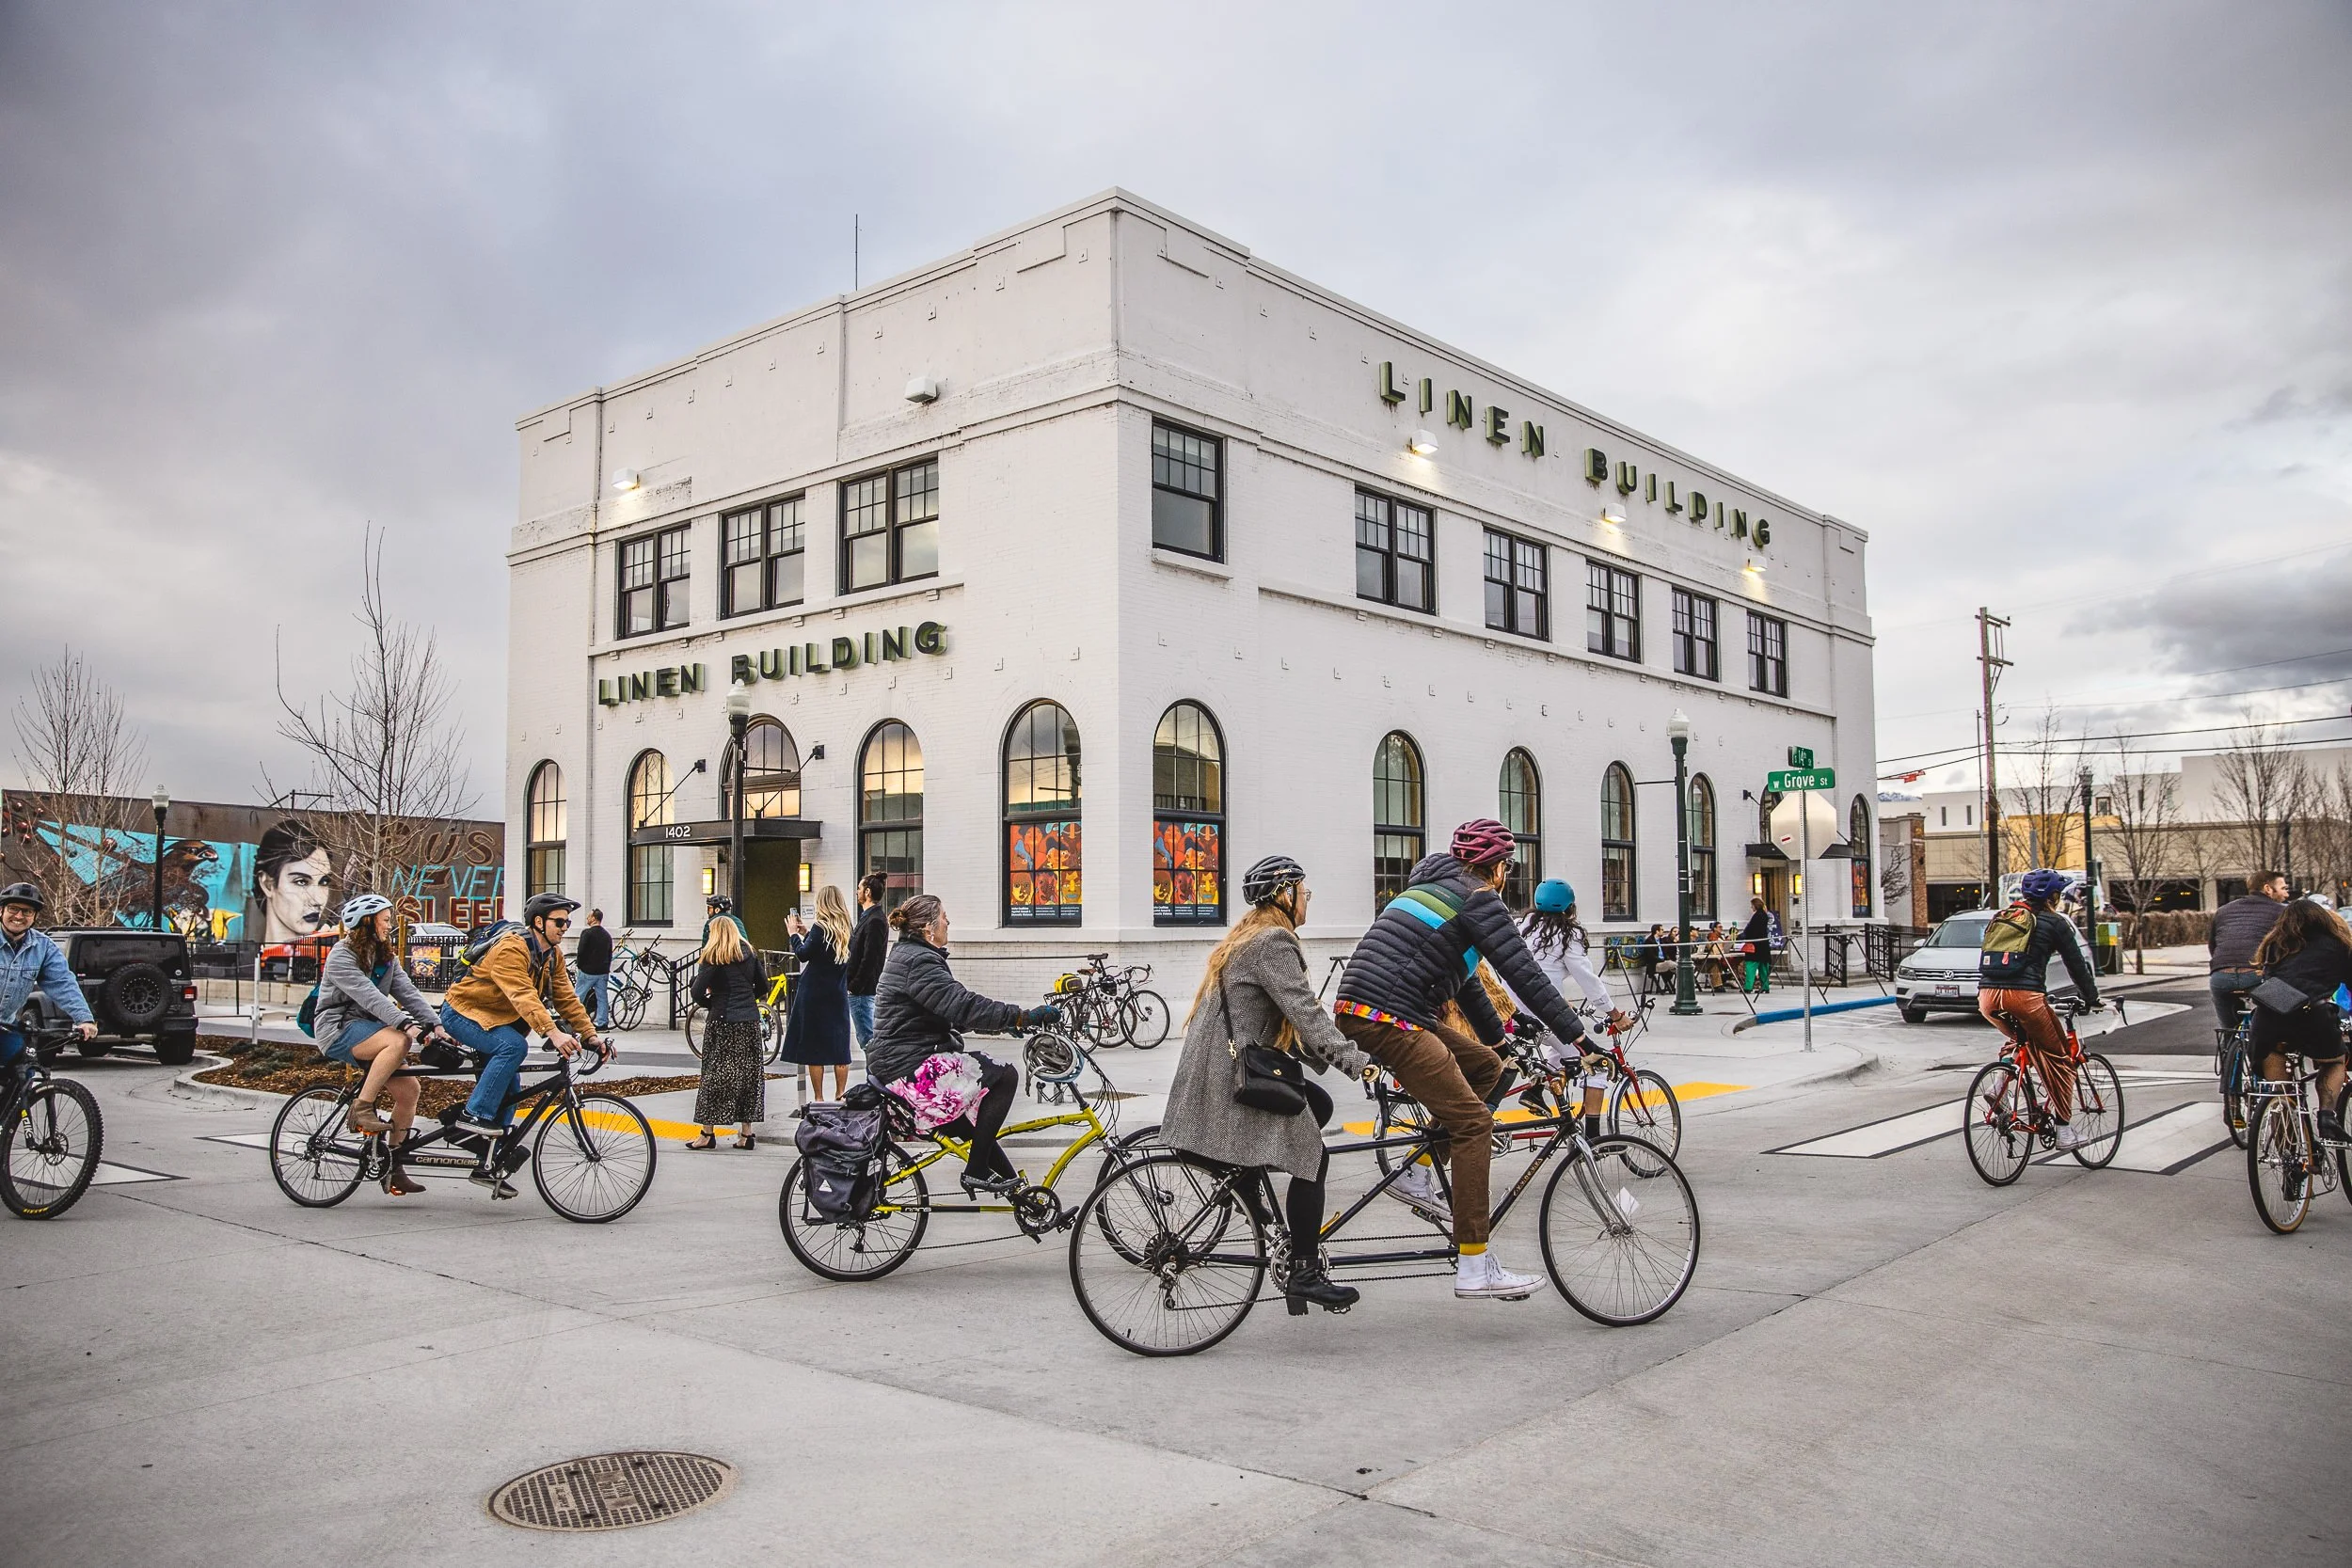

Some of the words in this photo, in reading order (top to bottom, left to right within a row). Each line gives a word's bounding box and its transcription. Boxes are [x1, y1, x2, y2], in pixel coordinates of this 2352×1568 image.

[1379, 361, 1545, 458] LINEN
[1584, 448, 1771, 547] BUILDING
[598, 662, 706, 707] LINEN
[731, 621, 948, 685] BUILDING
[1772, 780, 1780, 788] W
[1784, 772, 1815, 788] Grove
[1820, 777, 1828, 786] St
[665, 825, 691, 839] 1402
[415, 1155, 480, 1167] cannondale
